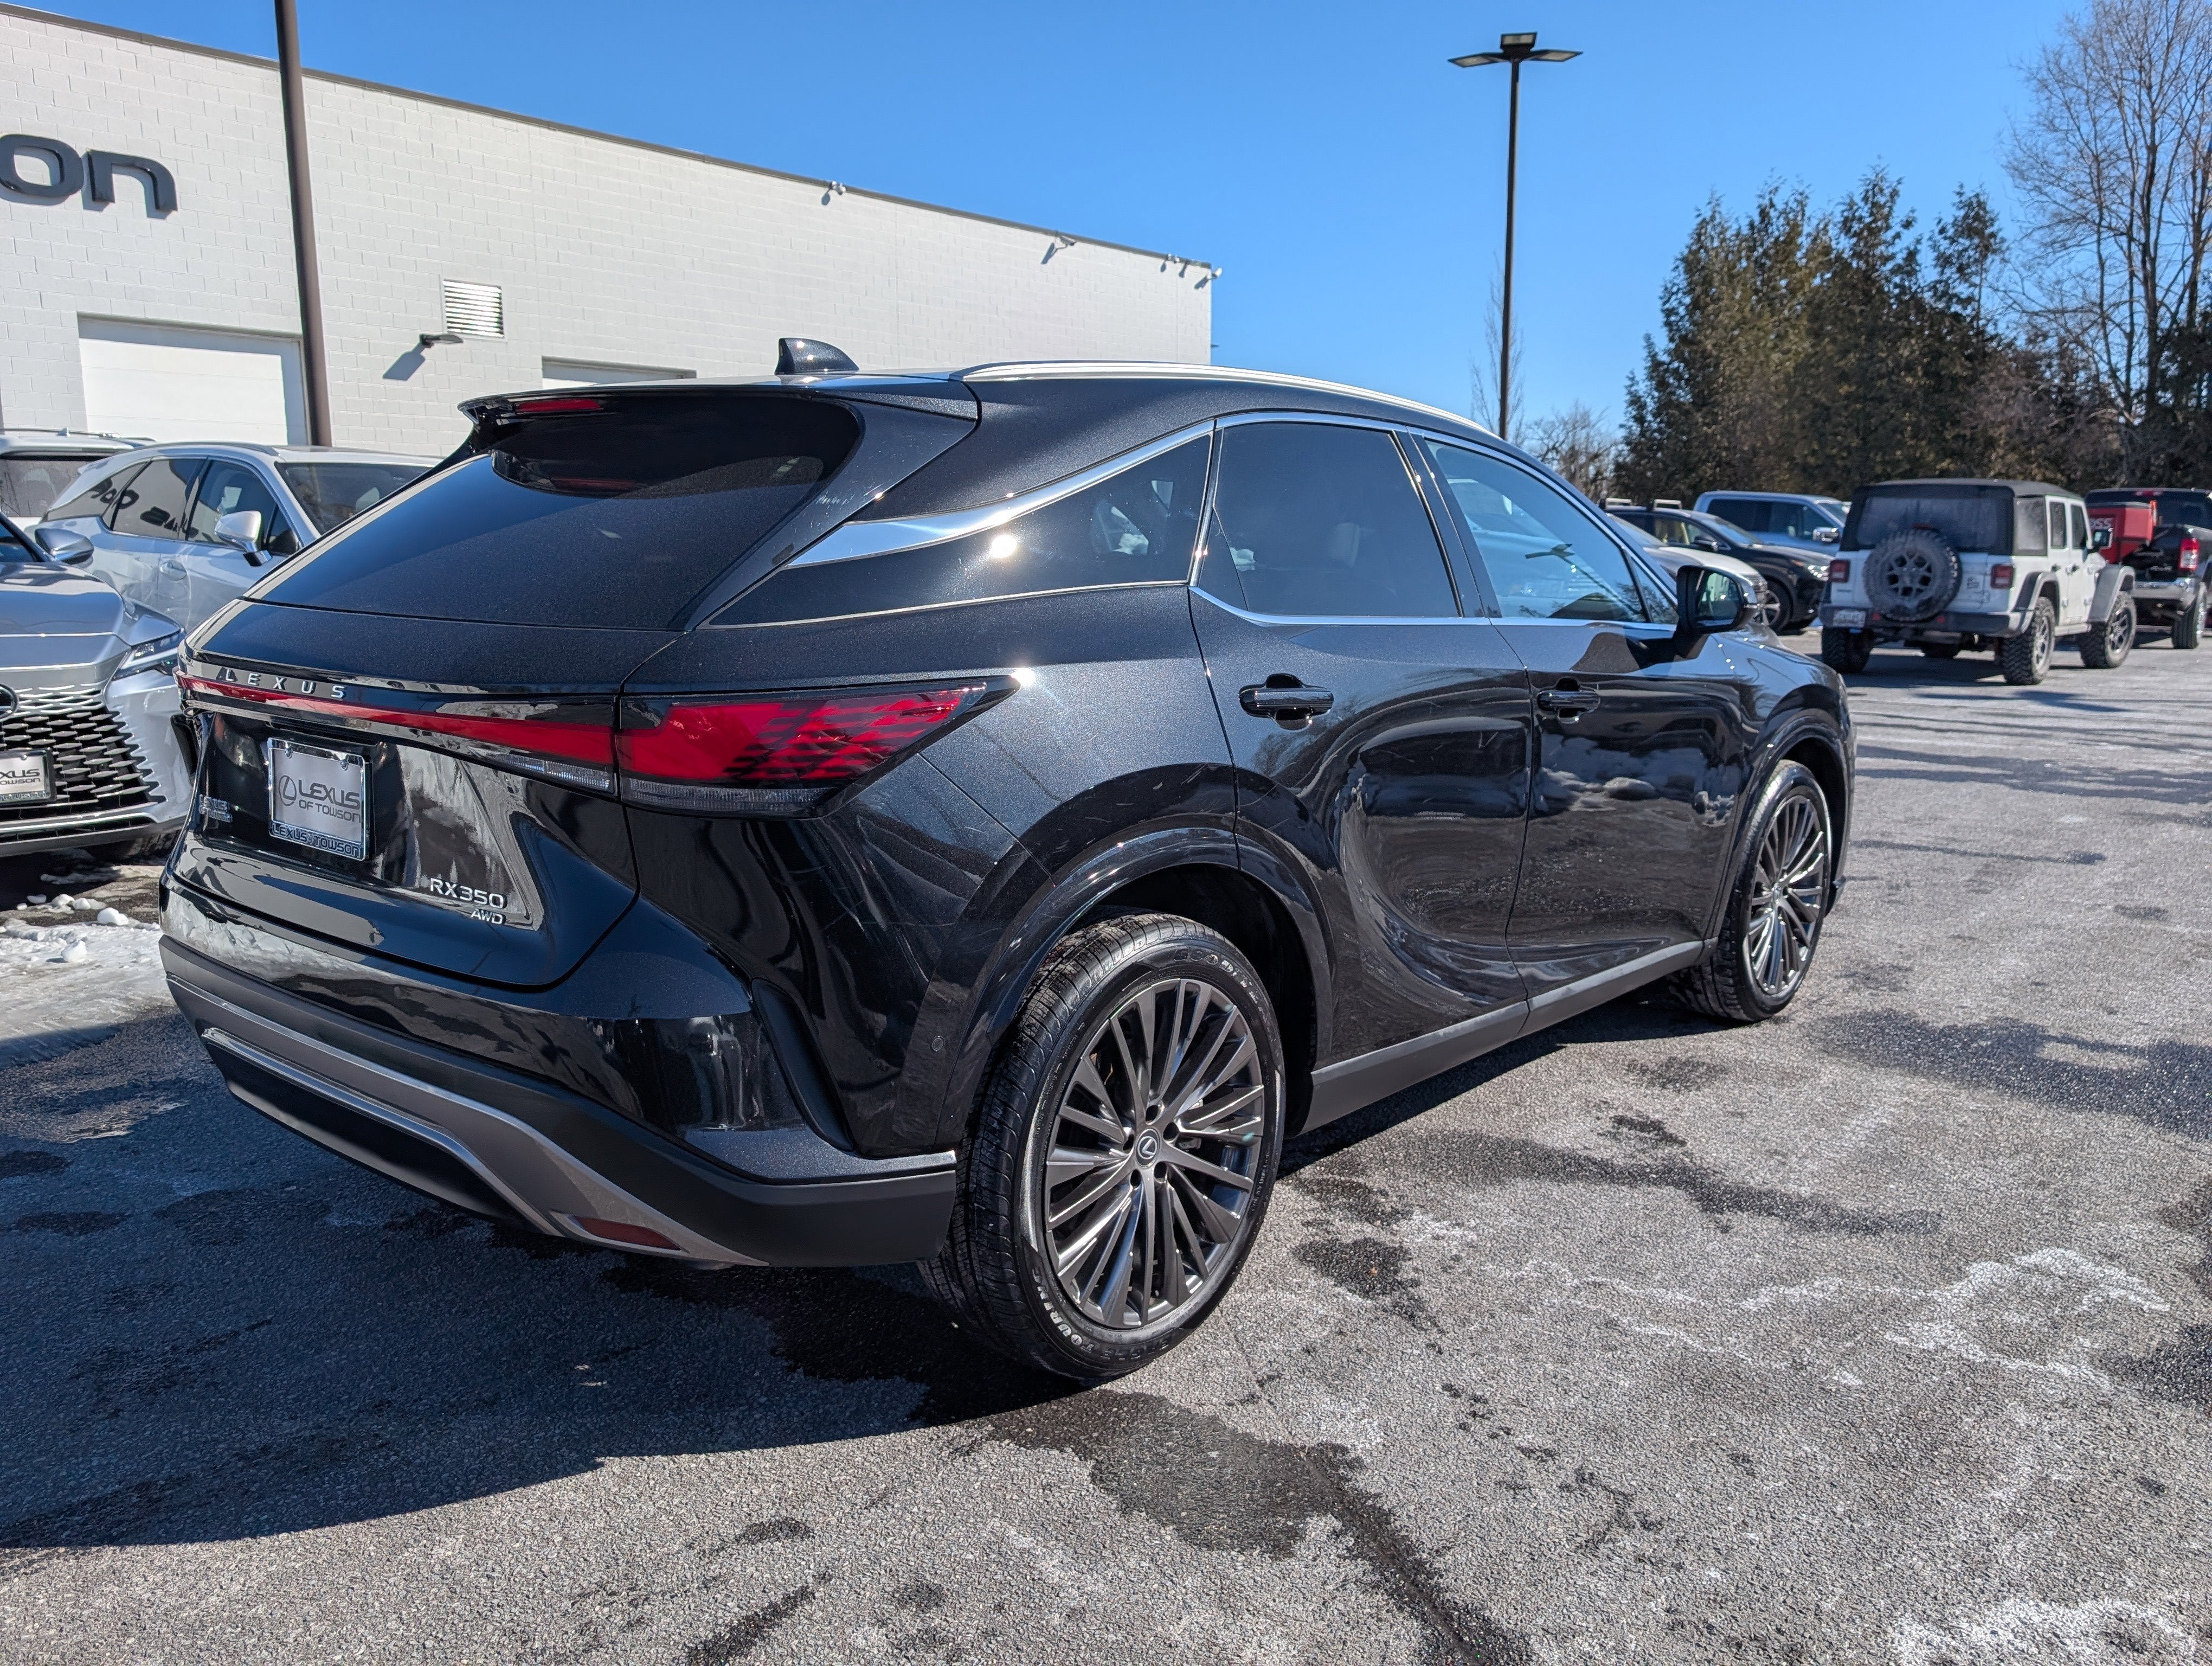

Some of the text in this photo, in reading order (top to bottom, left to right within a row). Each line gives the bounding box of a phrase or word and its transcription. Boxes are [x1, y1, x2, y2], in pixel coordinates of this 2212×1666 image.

[225, 669, 345, 699] LEXUS
[298, 779, 361, 810] LEXUS
[299, 799, 361, 823] OF TOWSON
[272, 823, 308, 842] LEXUS
[312, 836, 361, 858] TOWSON
[430, 877, 505, 909] RX350
[471, 908, 503, 925] AWD
